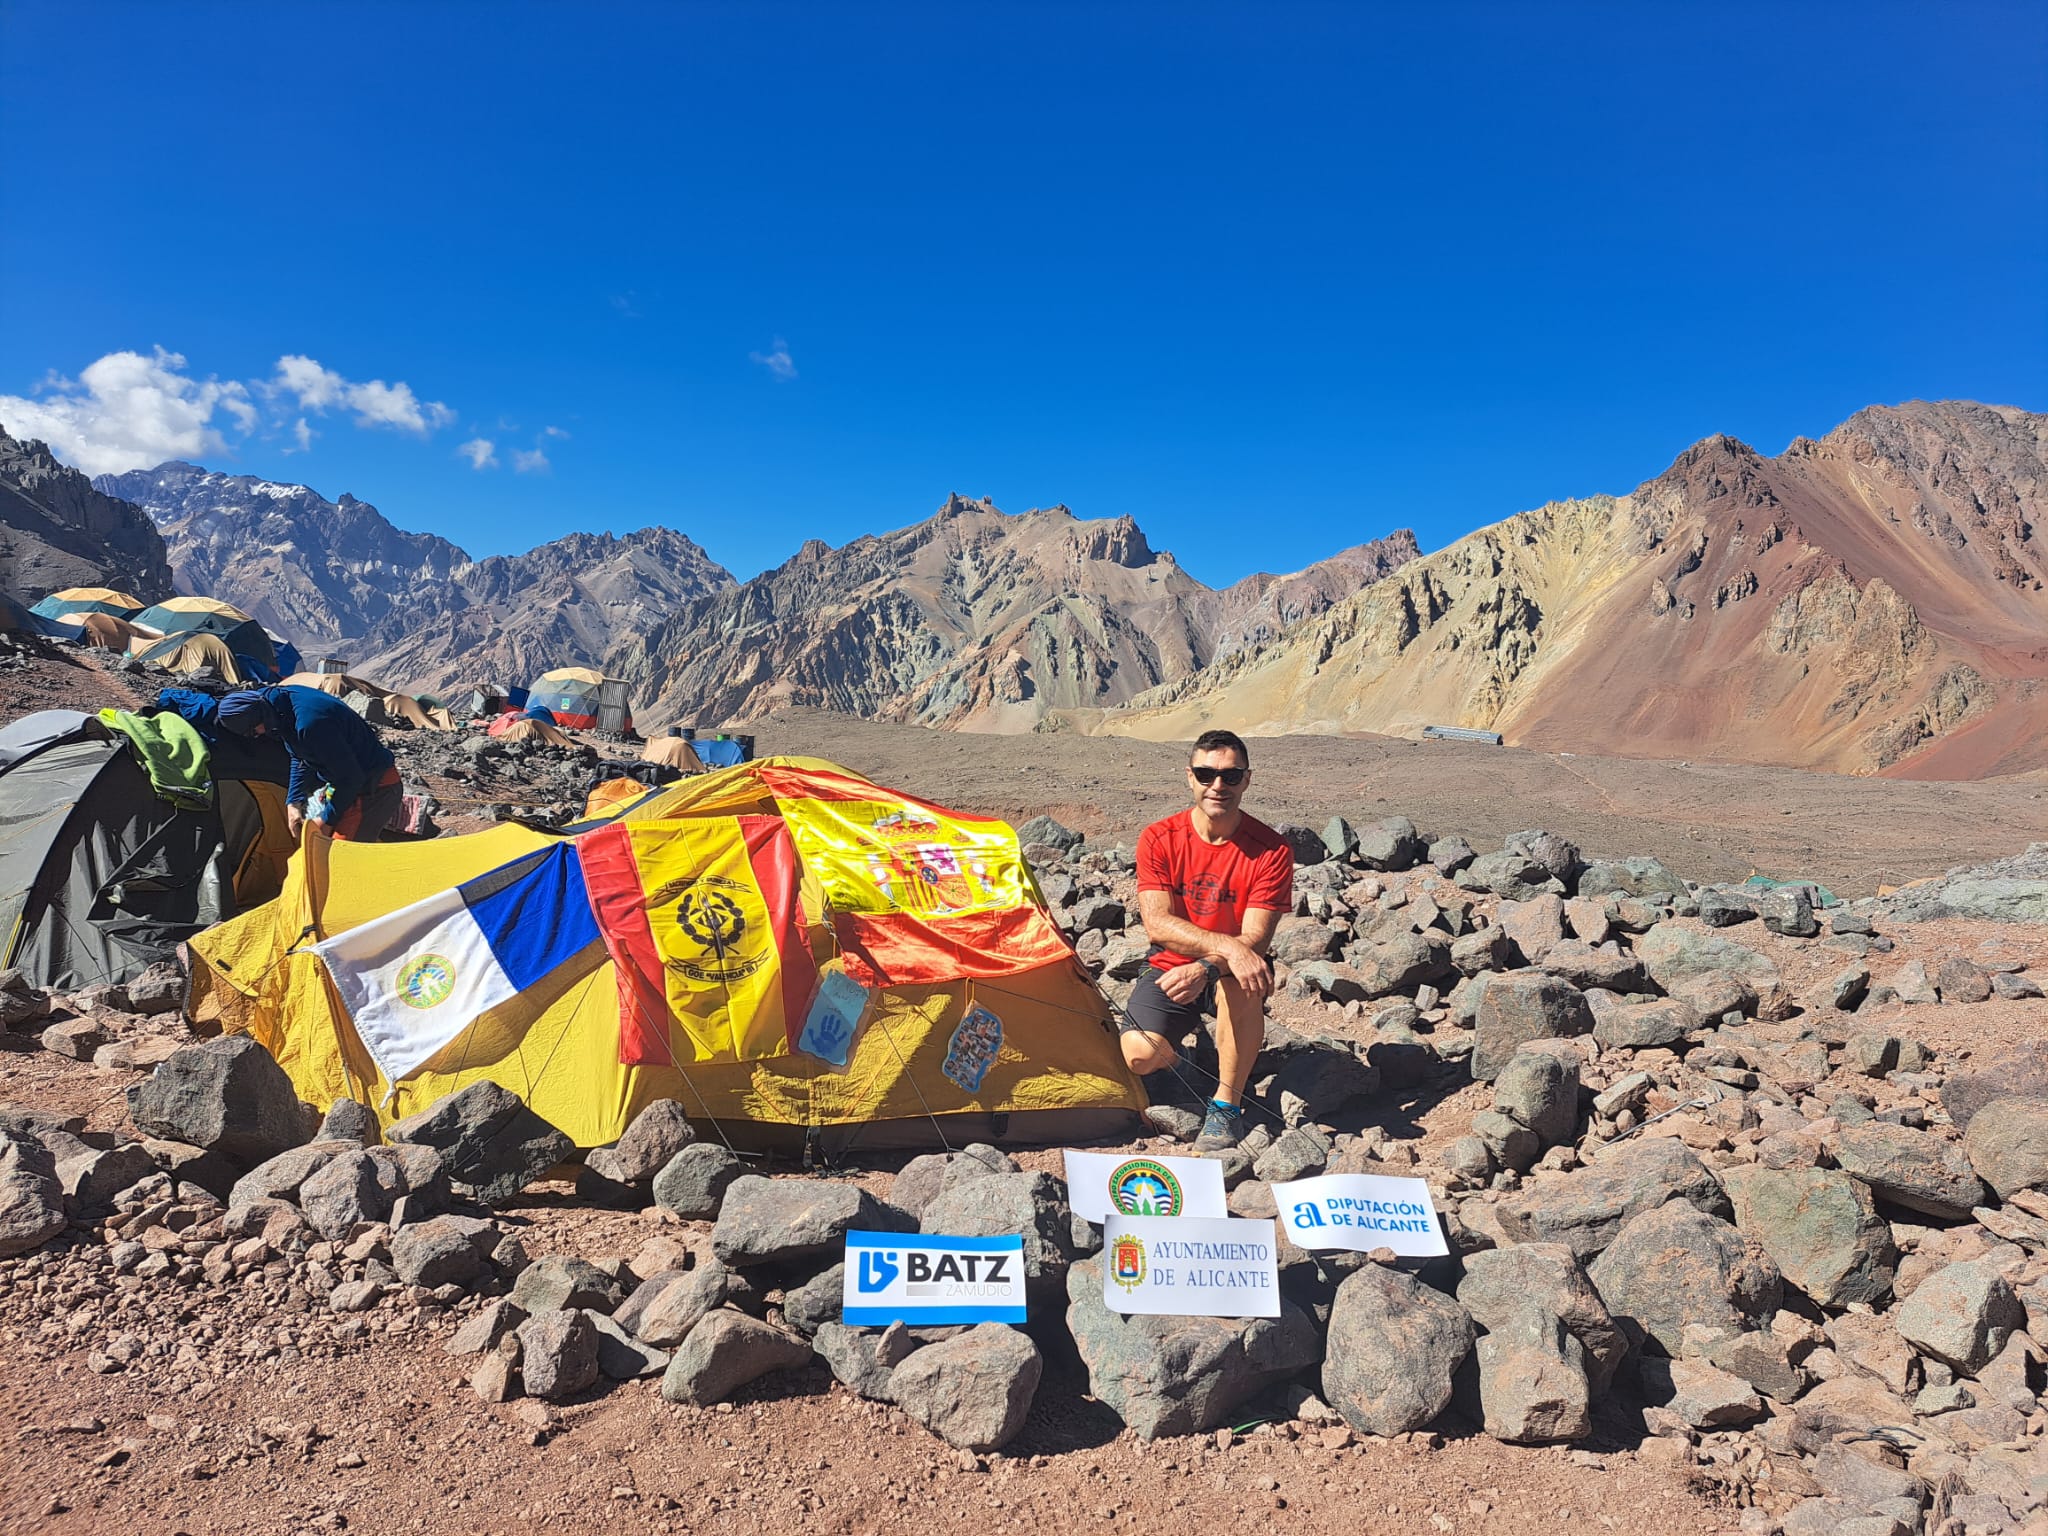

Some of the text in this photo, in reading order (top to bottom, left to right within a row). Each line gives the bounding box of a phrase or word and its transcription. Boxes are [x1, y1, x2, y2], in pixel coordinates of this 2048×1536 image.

[1162, 1171, 1171, 1180] DE
[1326, 1198, 1425, 1216] DIPUTACIÓN
[1331, 1213, 1430, 1232] DE ALICANTE
[1153, 1241, 1268, 1261] AYUNTAMIENTO
[906, 1252, 1011, 1283] BATZ
[1153, 1268, 1270, 1288] DE ALICANTE
[945, 1284, 1013, 1297] ZAMUDIO
